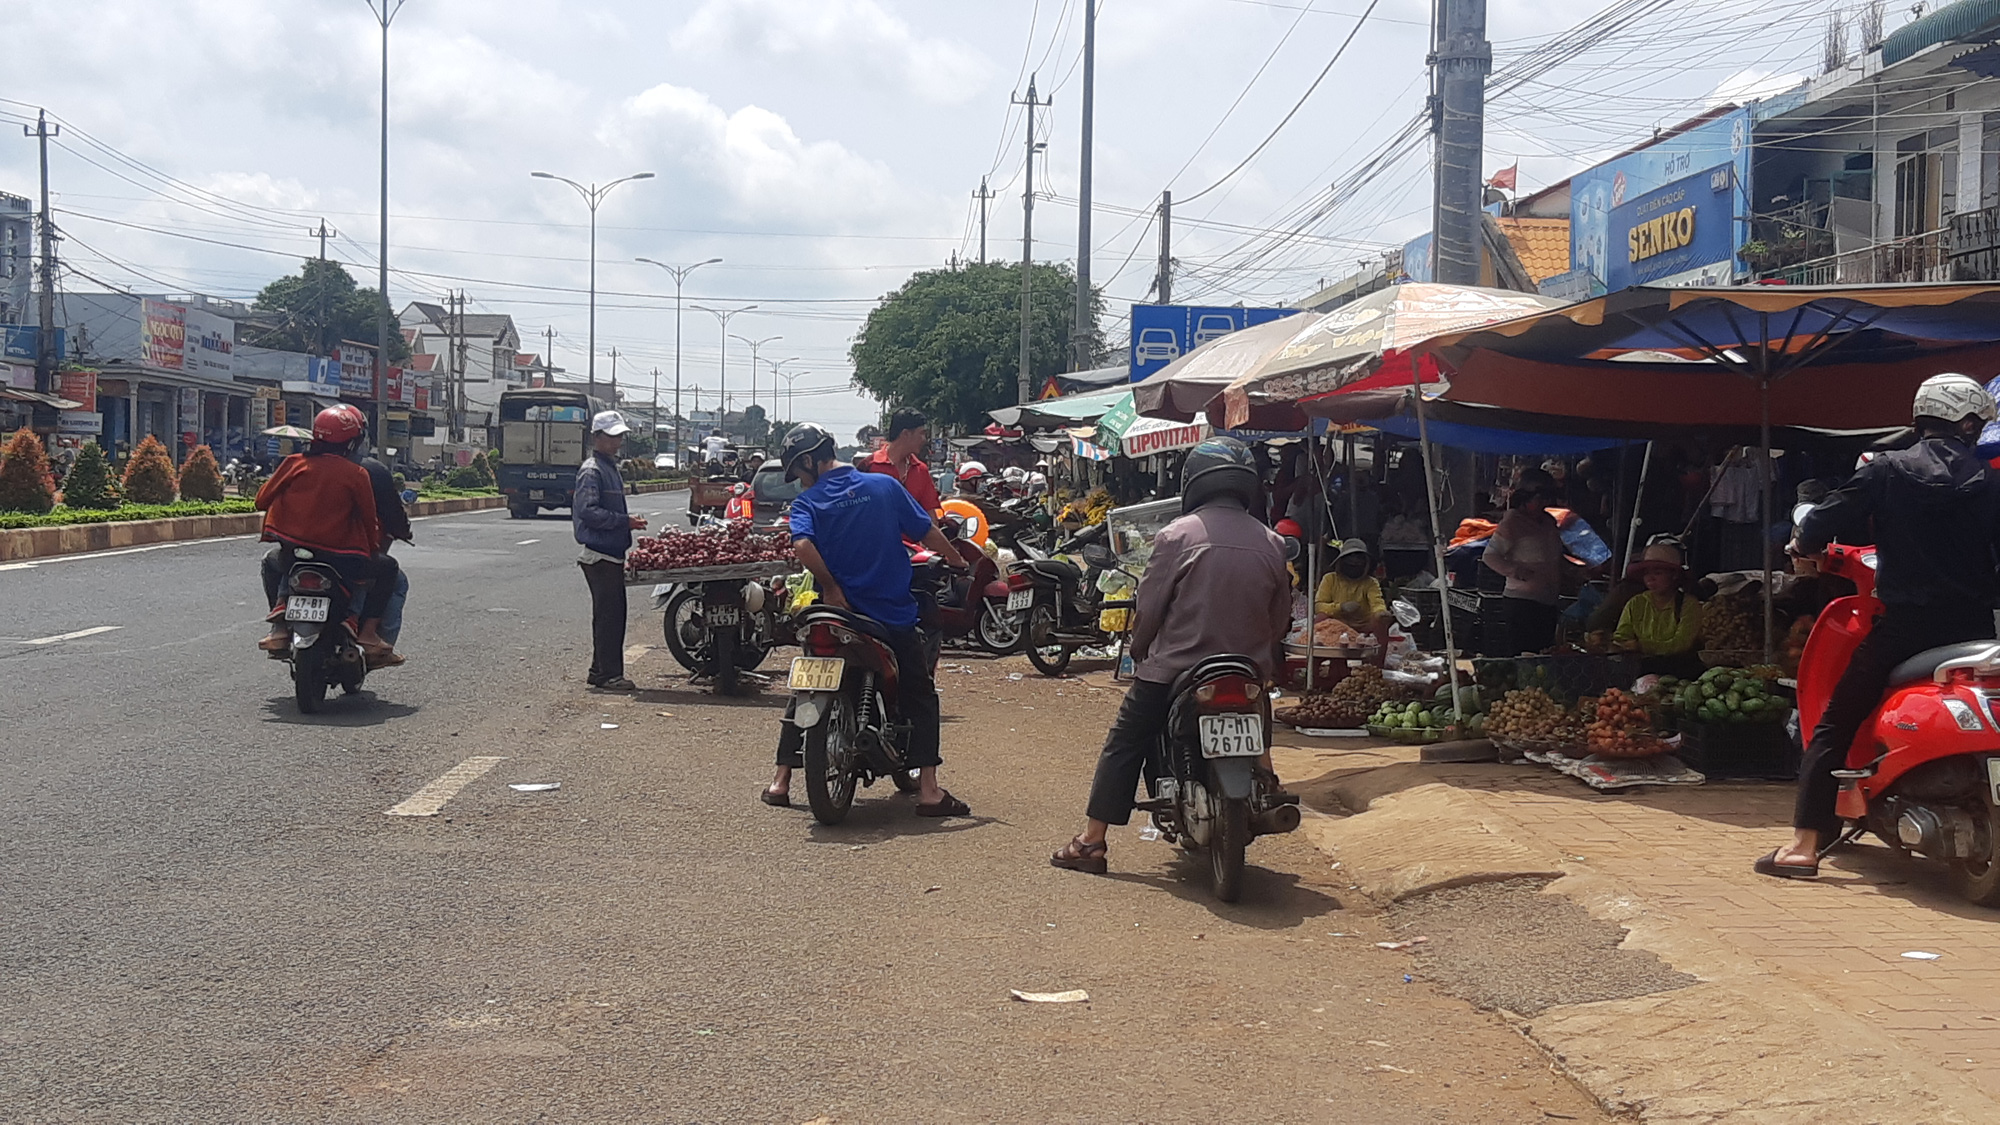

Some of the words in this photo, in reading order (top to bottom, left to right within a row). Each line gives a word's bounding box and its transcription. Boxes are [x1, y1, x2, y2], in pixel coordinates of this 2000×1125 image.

[1628, 208, 1694, 263] SENKO
[1129, 425, 1201, 455] LIPOVITAN
[295, 598, 323, 609] 47-B1
[796, 674, 833, 688] 8810
[1210, 718, 1250, 735] 47-H1
[1211, 736, 1254, 753] 2670
